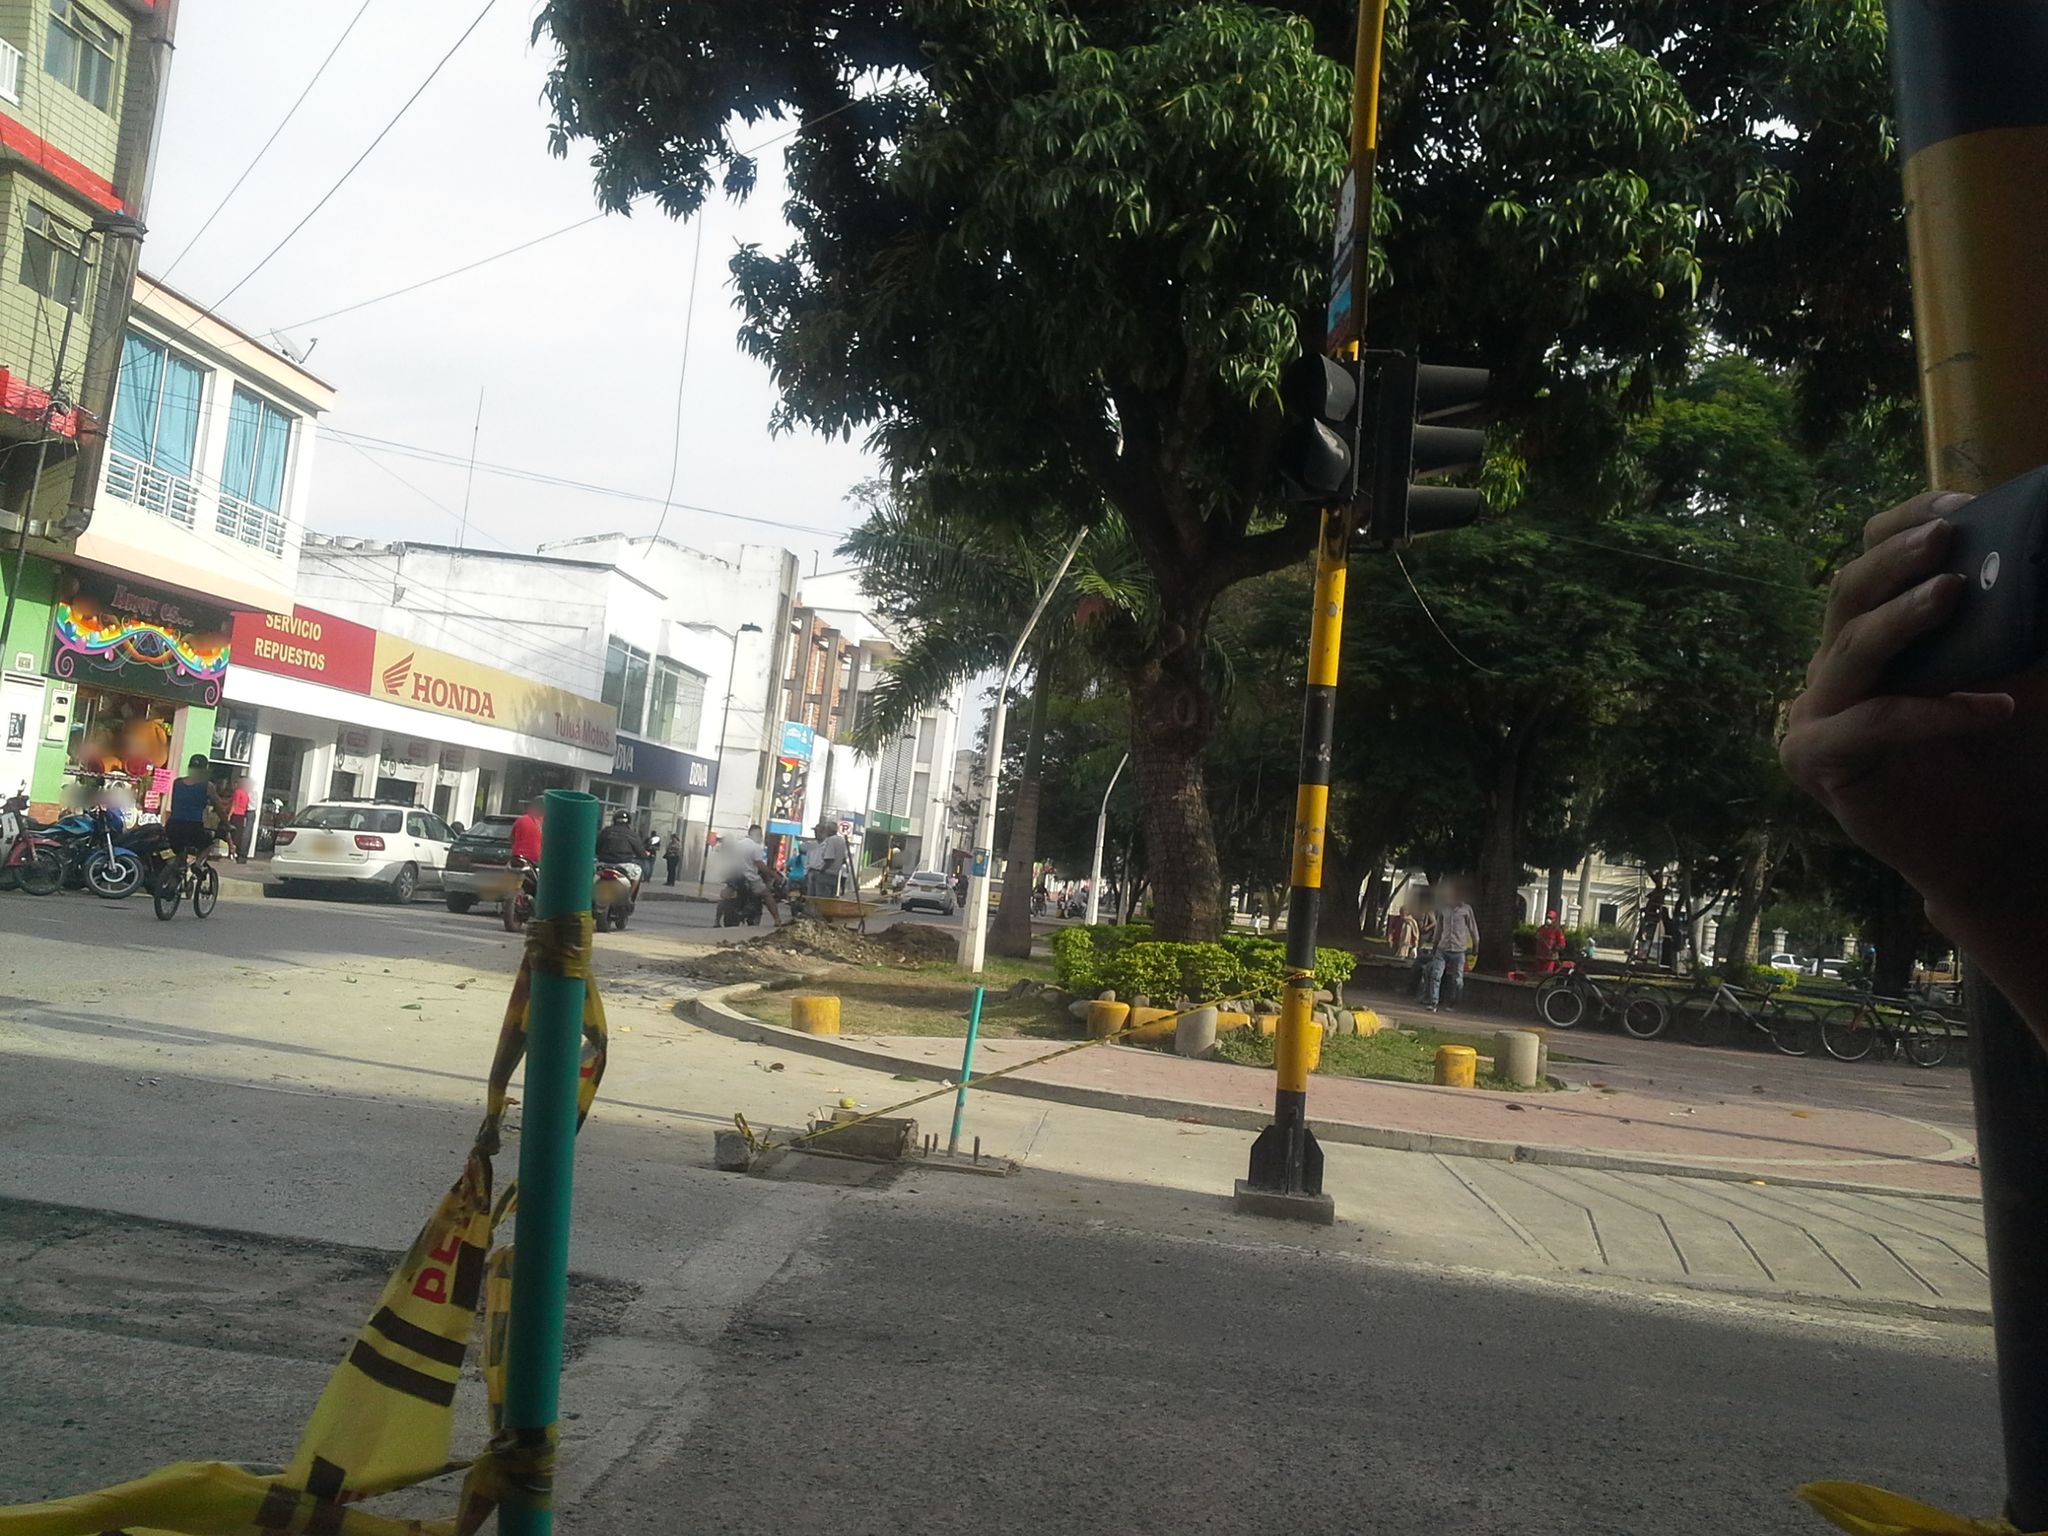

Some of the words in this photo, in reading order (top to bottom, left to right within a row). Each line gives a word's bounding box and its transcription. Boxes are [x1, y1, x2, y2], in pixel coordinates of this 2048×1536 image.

[265, 614, 322, 641] SERVICIO
[254, 637, 326, 671] REPUESTOS
[411, 671, 495, 719] HONDA
[555, 712, 581, 738] Tuluá
[582, 721, 610, 747] Motos
[615, 743, 634, 773] BVA
[689, 761, 708, 787] BBVA
